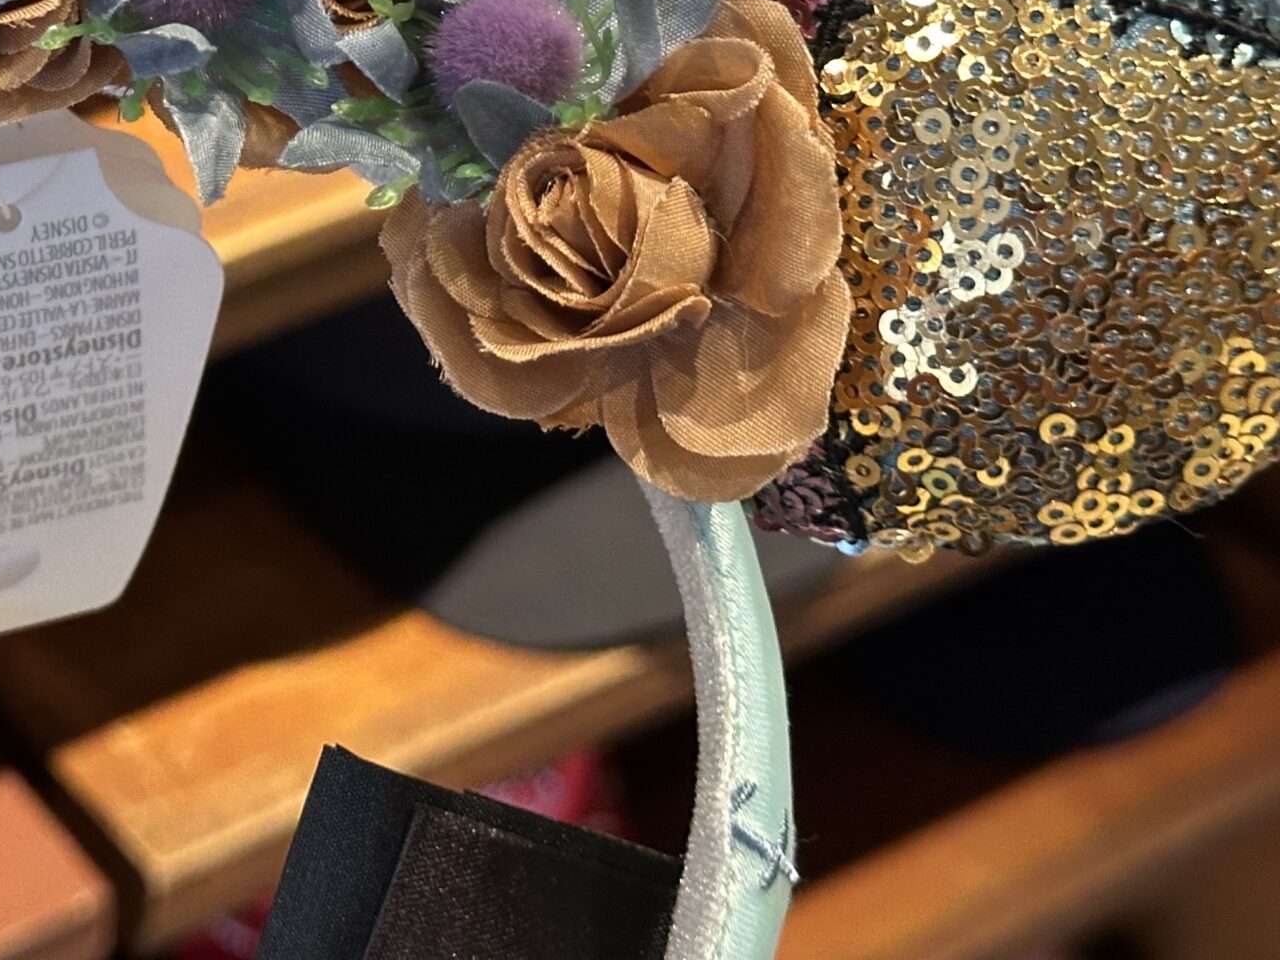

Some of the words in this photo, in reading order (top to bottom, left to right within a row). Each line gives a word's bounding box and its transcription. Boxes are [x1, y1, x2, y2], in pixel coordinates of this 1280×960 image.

[29, 214, 87, 243] DISNEY
[16, 236, 92, 268] CORRETTO
[63, 252, 108, 278] VISITA
[43, 279, 81, 302] KONG
[82, 271, 122, 294] HONG
